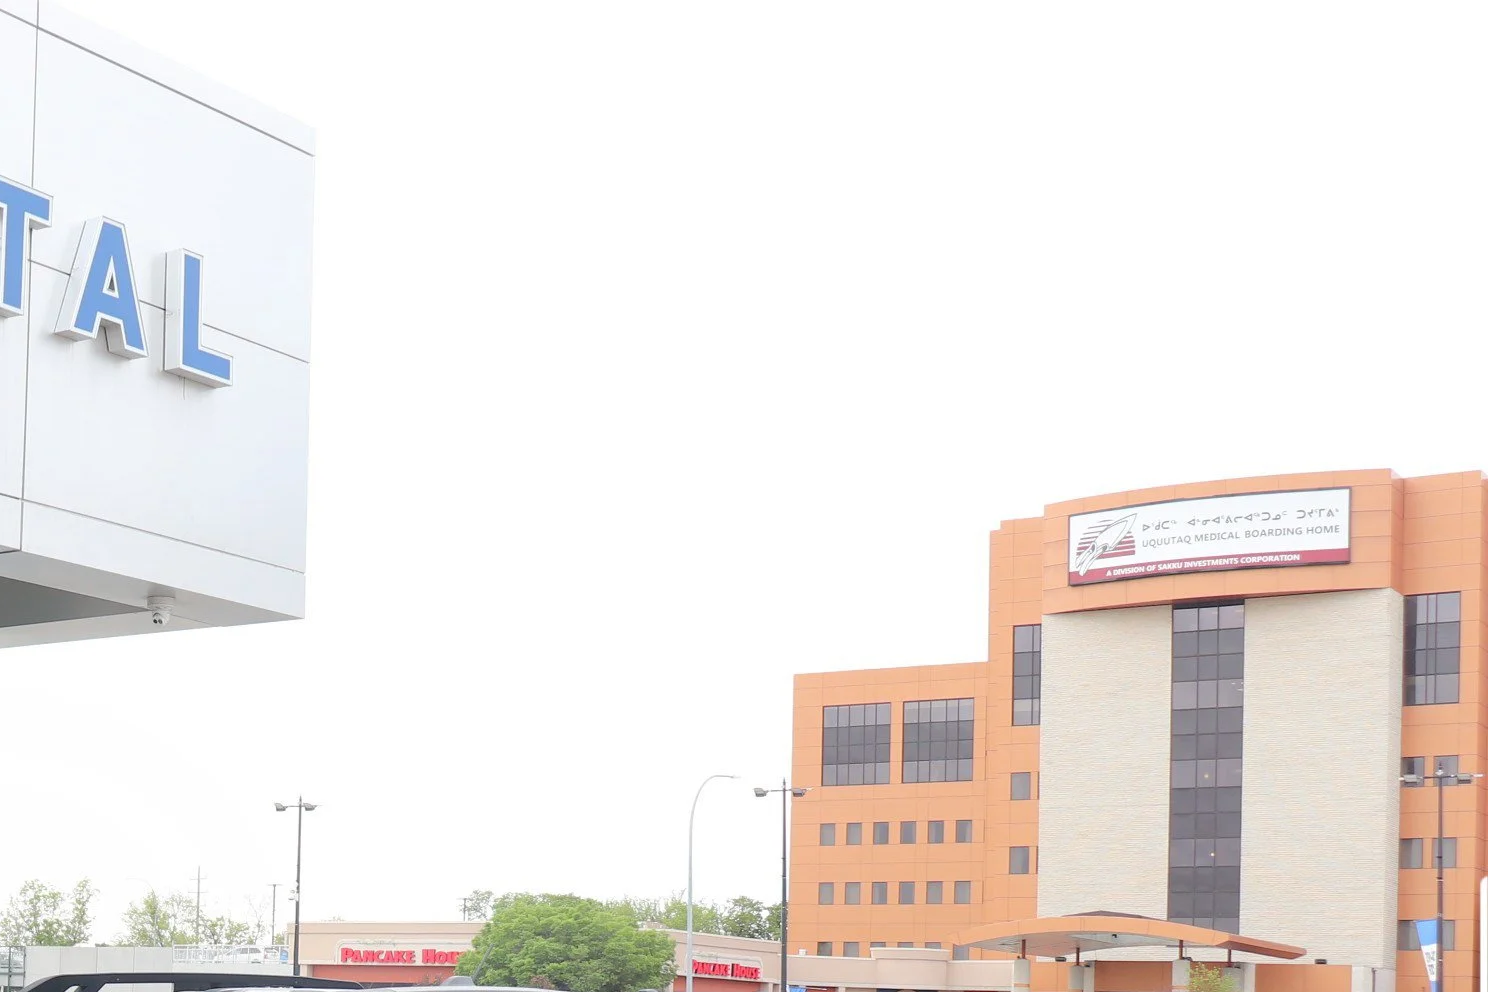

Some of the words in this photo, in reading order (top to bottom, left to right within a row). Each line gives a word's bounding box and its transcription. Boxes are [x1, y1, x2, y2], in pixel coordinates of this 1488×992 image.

[1142, 534, 1192, 549] UQUUTAQ
[1194, 530, 1241, 542] MEDICAL
[1244, 526, 1304, 538] BOARDING
[1306, 523, 1341, 535] HOME
[1106, 569, 1112, 577] A
[1113, 566, 1145, 576] DIVISION
[1146, 564, 1157, 573] OF
[1158, 562, 1183, 571] SAKKU
[1184, 557, 1239, 569] INVESTMENTS
[1241, 553, 1300, 565] CORPORATION
[341, 947, 416, 964] PANCAKE
[422, 949, 463, 964] HOU
[692, 959, 731, 977] PANCAKE
[731, 963, 761, 980] HOUSE
